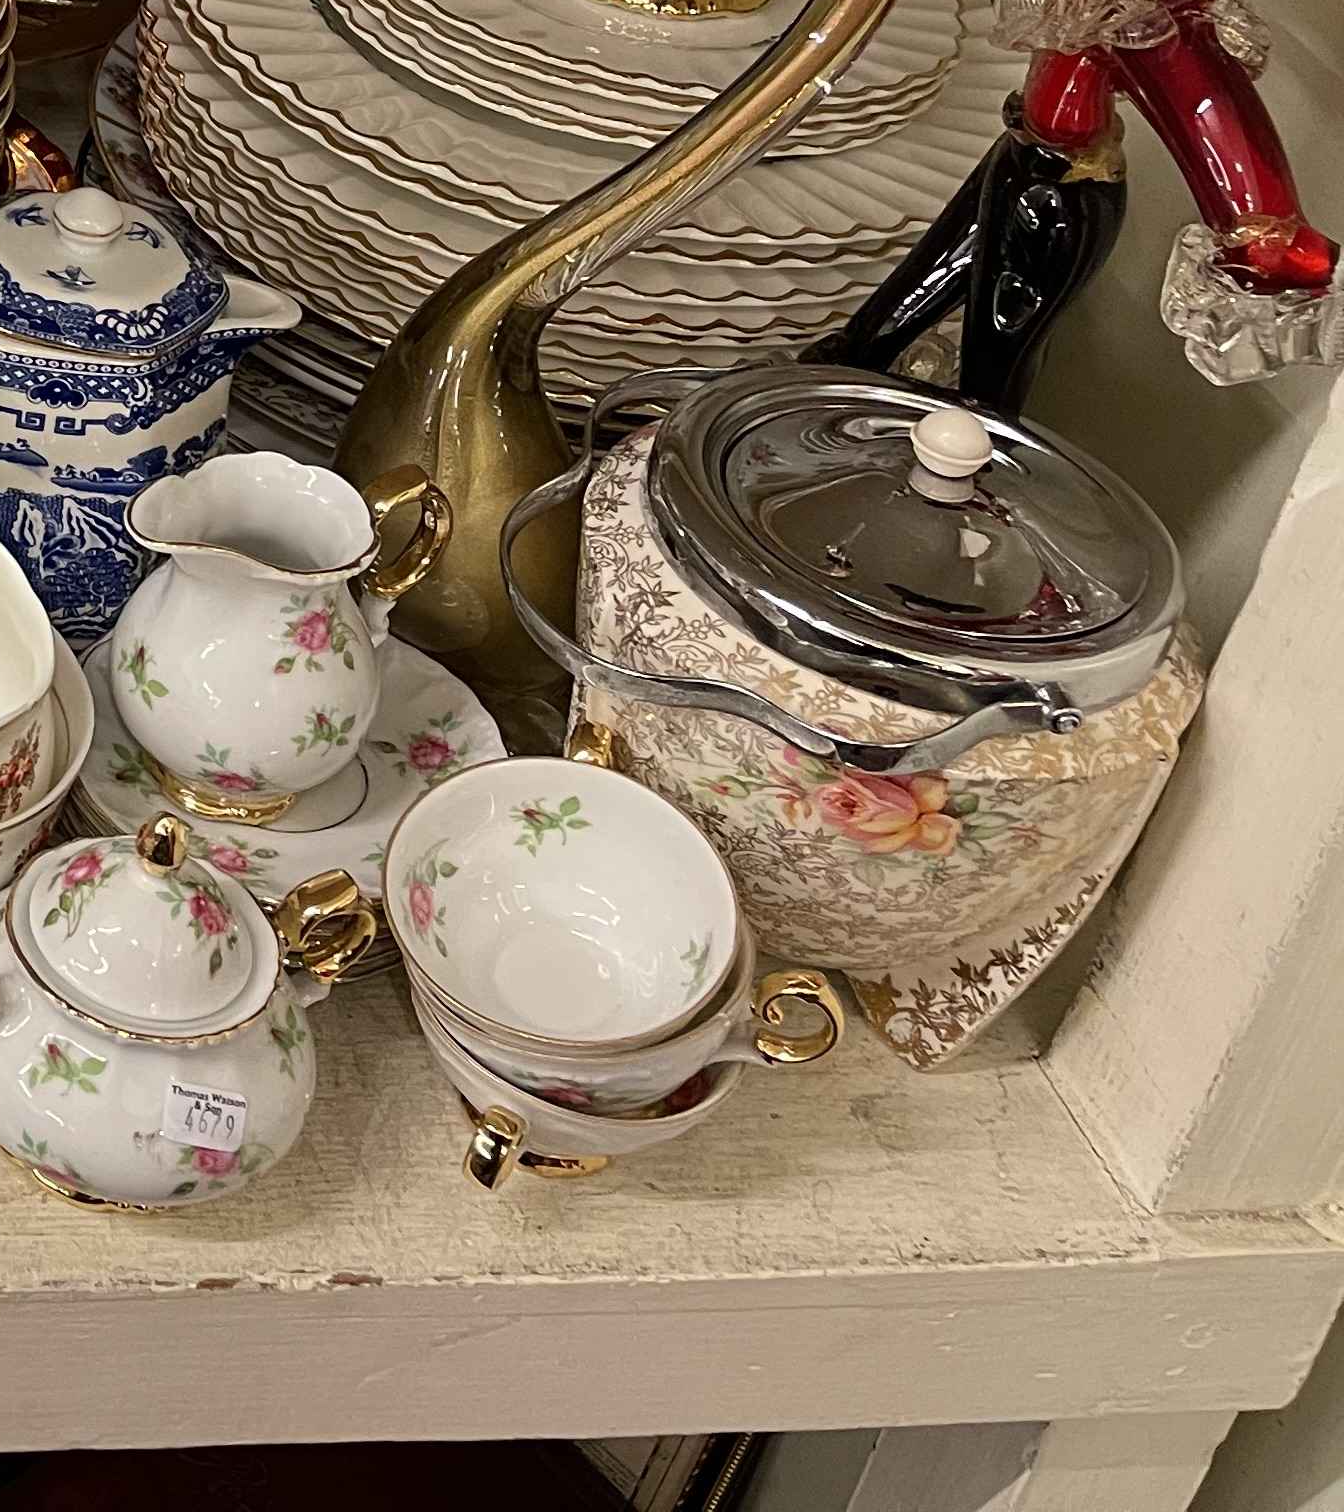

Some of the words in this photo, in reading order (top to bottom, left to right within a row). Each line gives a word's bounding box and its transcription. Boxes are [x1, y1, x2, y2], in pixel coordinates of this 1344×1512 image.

[172, 1084, 209, 1101] Thomas
[194, 1100, 201, 1110] &
[205, 1102, 222, 1116] Son
[184, 1106, 235, 1140] 4679
